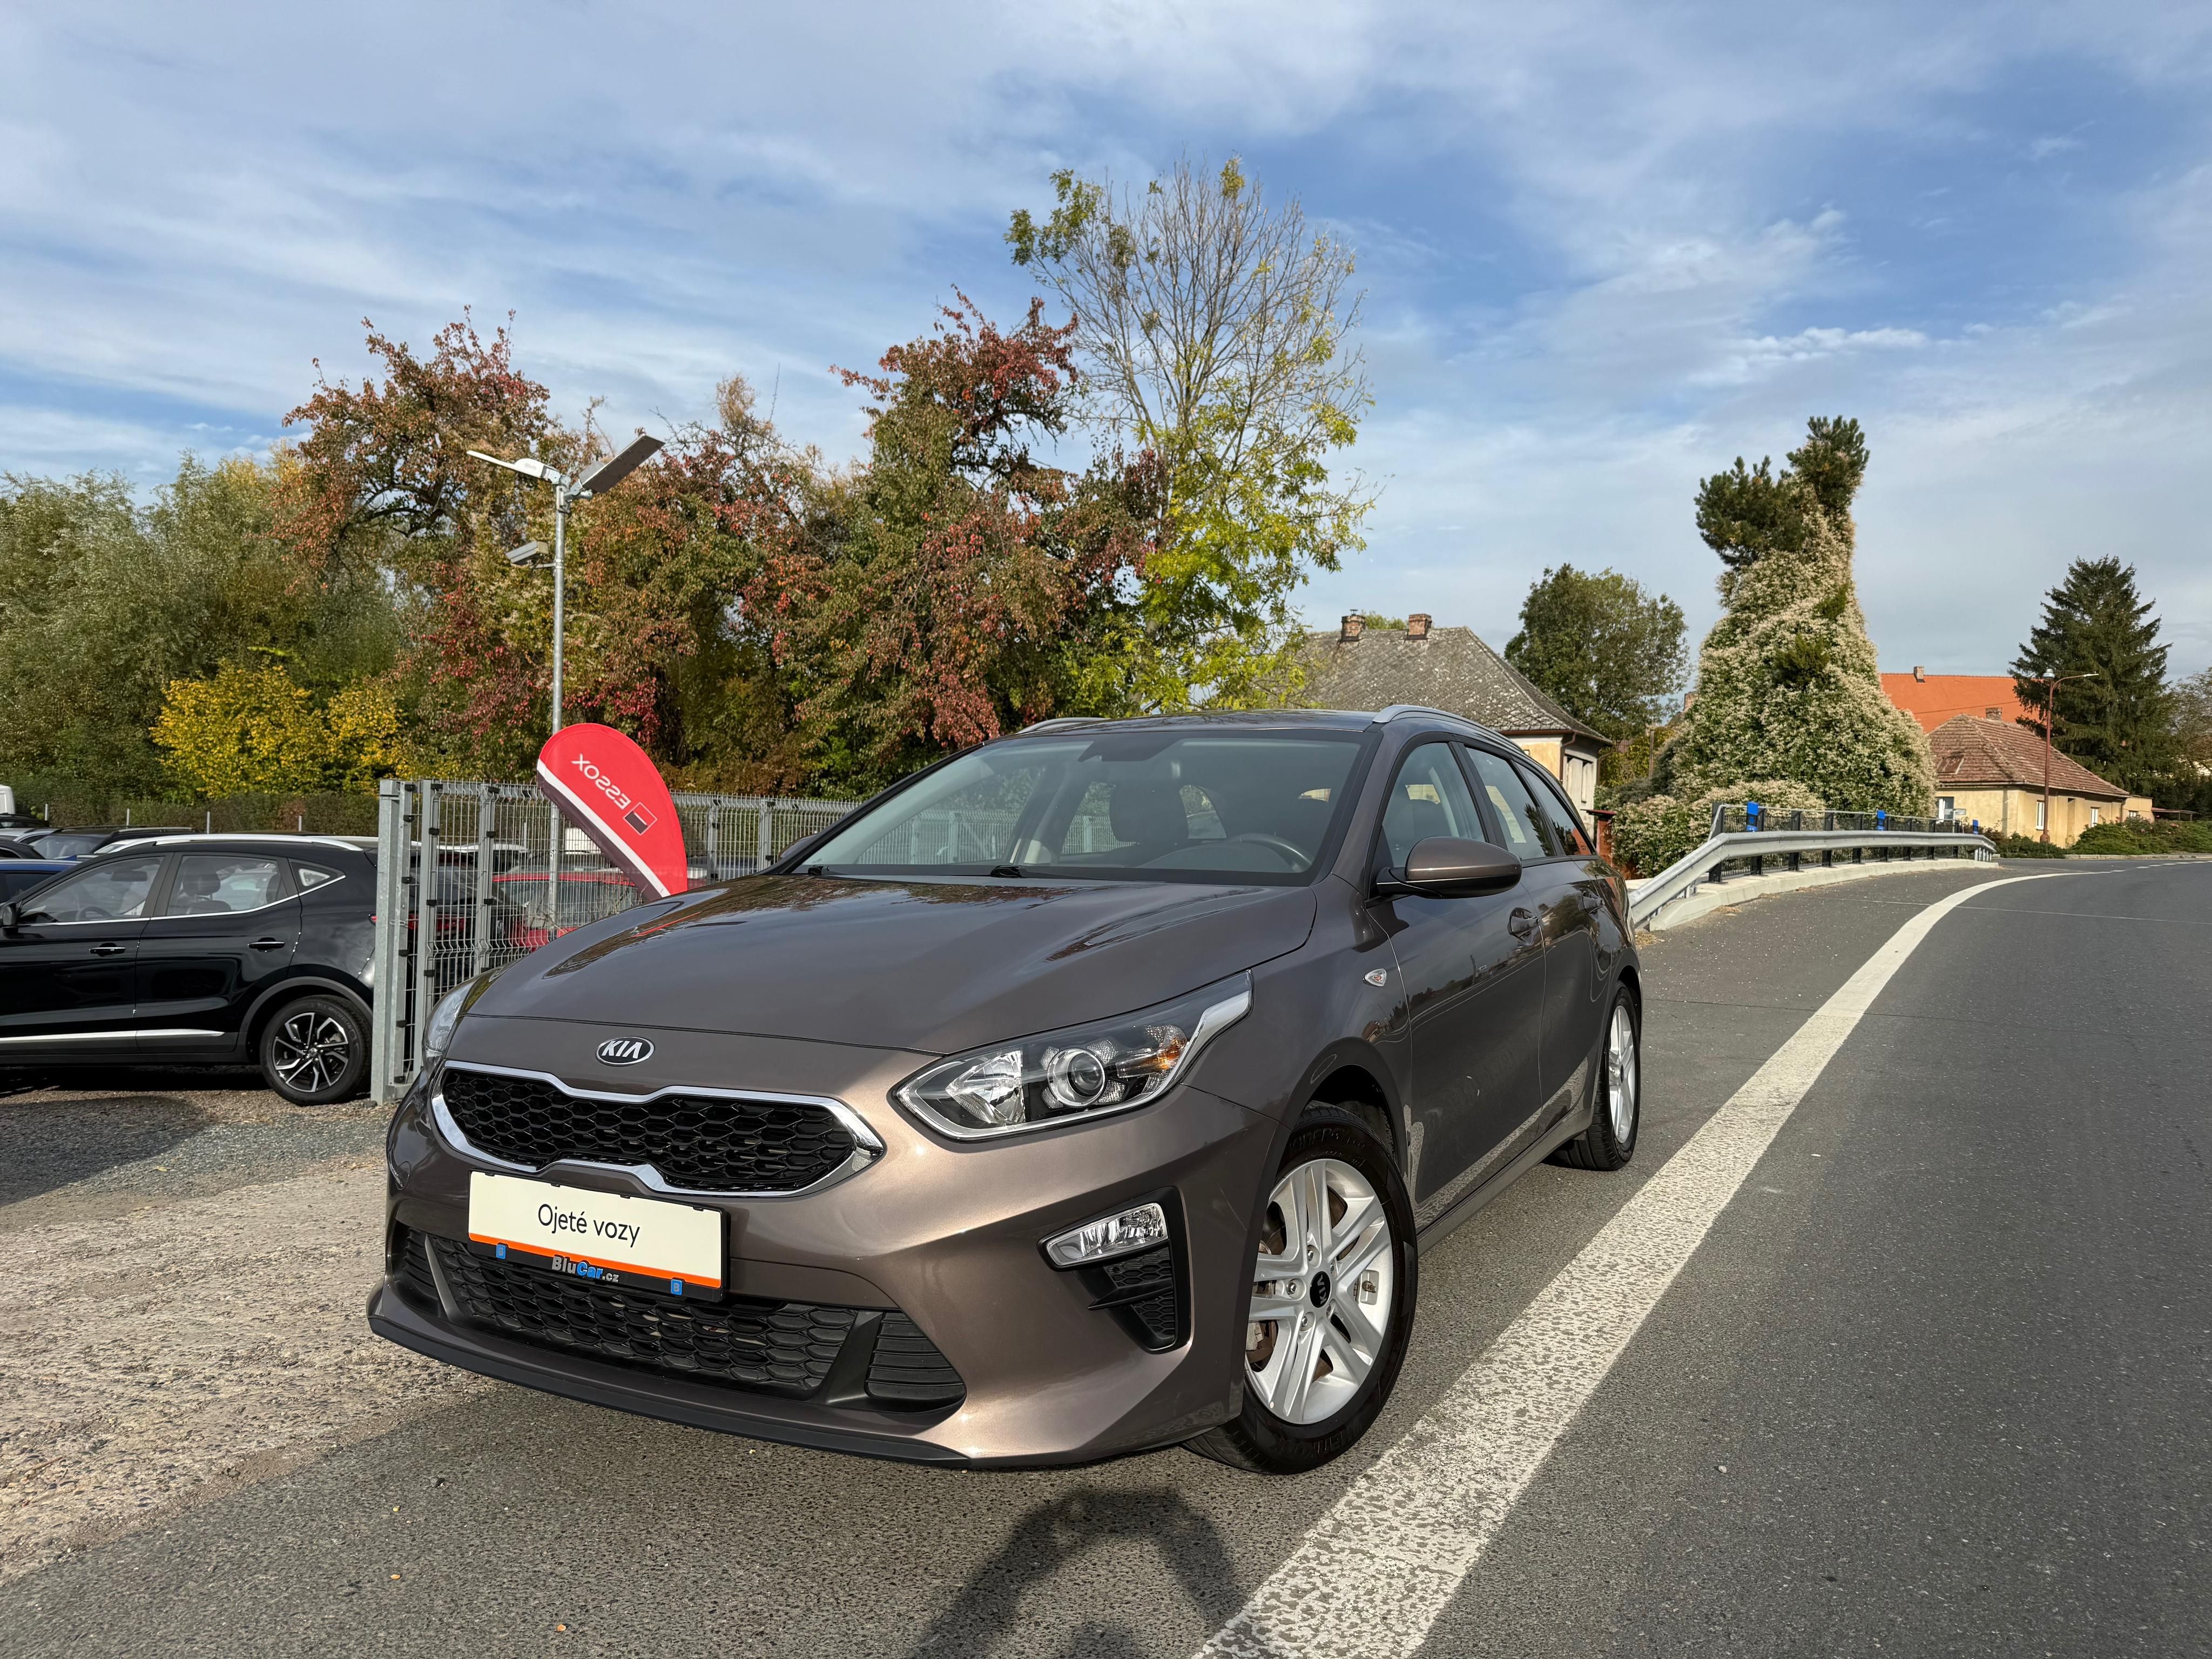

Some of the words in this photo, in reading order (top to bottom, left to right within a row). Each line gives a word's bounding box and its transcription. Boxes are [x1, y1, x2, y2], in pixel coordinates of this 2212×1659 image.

[602, 1040, 643, 1059] KIA
[538, 1204, 587, 1234] Ojeté
[594, 1219, 640, 1247] vozy
[552, 1256, 619, 1283] BluCar.cz
[1317, 1274, 1327, 1305] KIA
